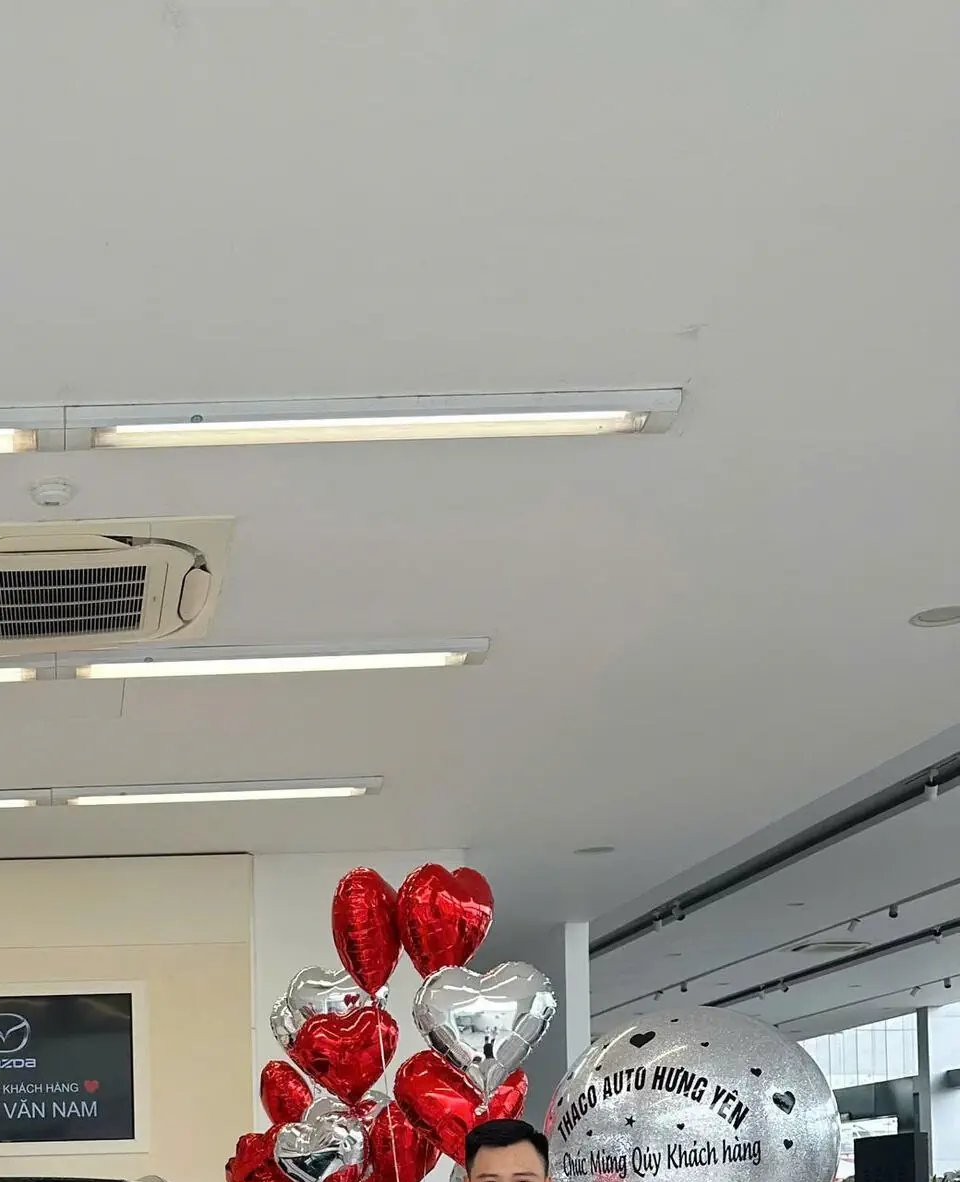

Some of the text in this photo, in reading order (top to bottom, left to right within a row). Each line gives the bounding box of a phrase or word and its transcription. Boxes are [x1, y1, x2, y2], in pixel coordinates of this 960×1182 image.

[2, 1080, 43, 1094] KHÁCH
[46, 1081, 79, 1093] HÀNG
[4, 1099, 45, 1119] VĂN
[53, 1101, 98, 1118] NAM
[557, 1065, 750, 1143] THACO AUTO HƯNG YÊN
[563, 1147, 588, 1178] Chúc
[667, 1140, 719, 1170] Khách
[722, 1135, 762, 1166] hàng
